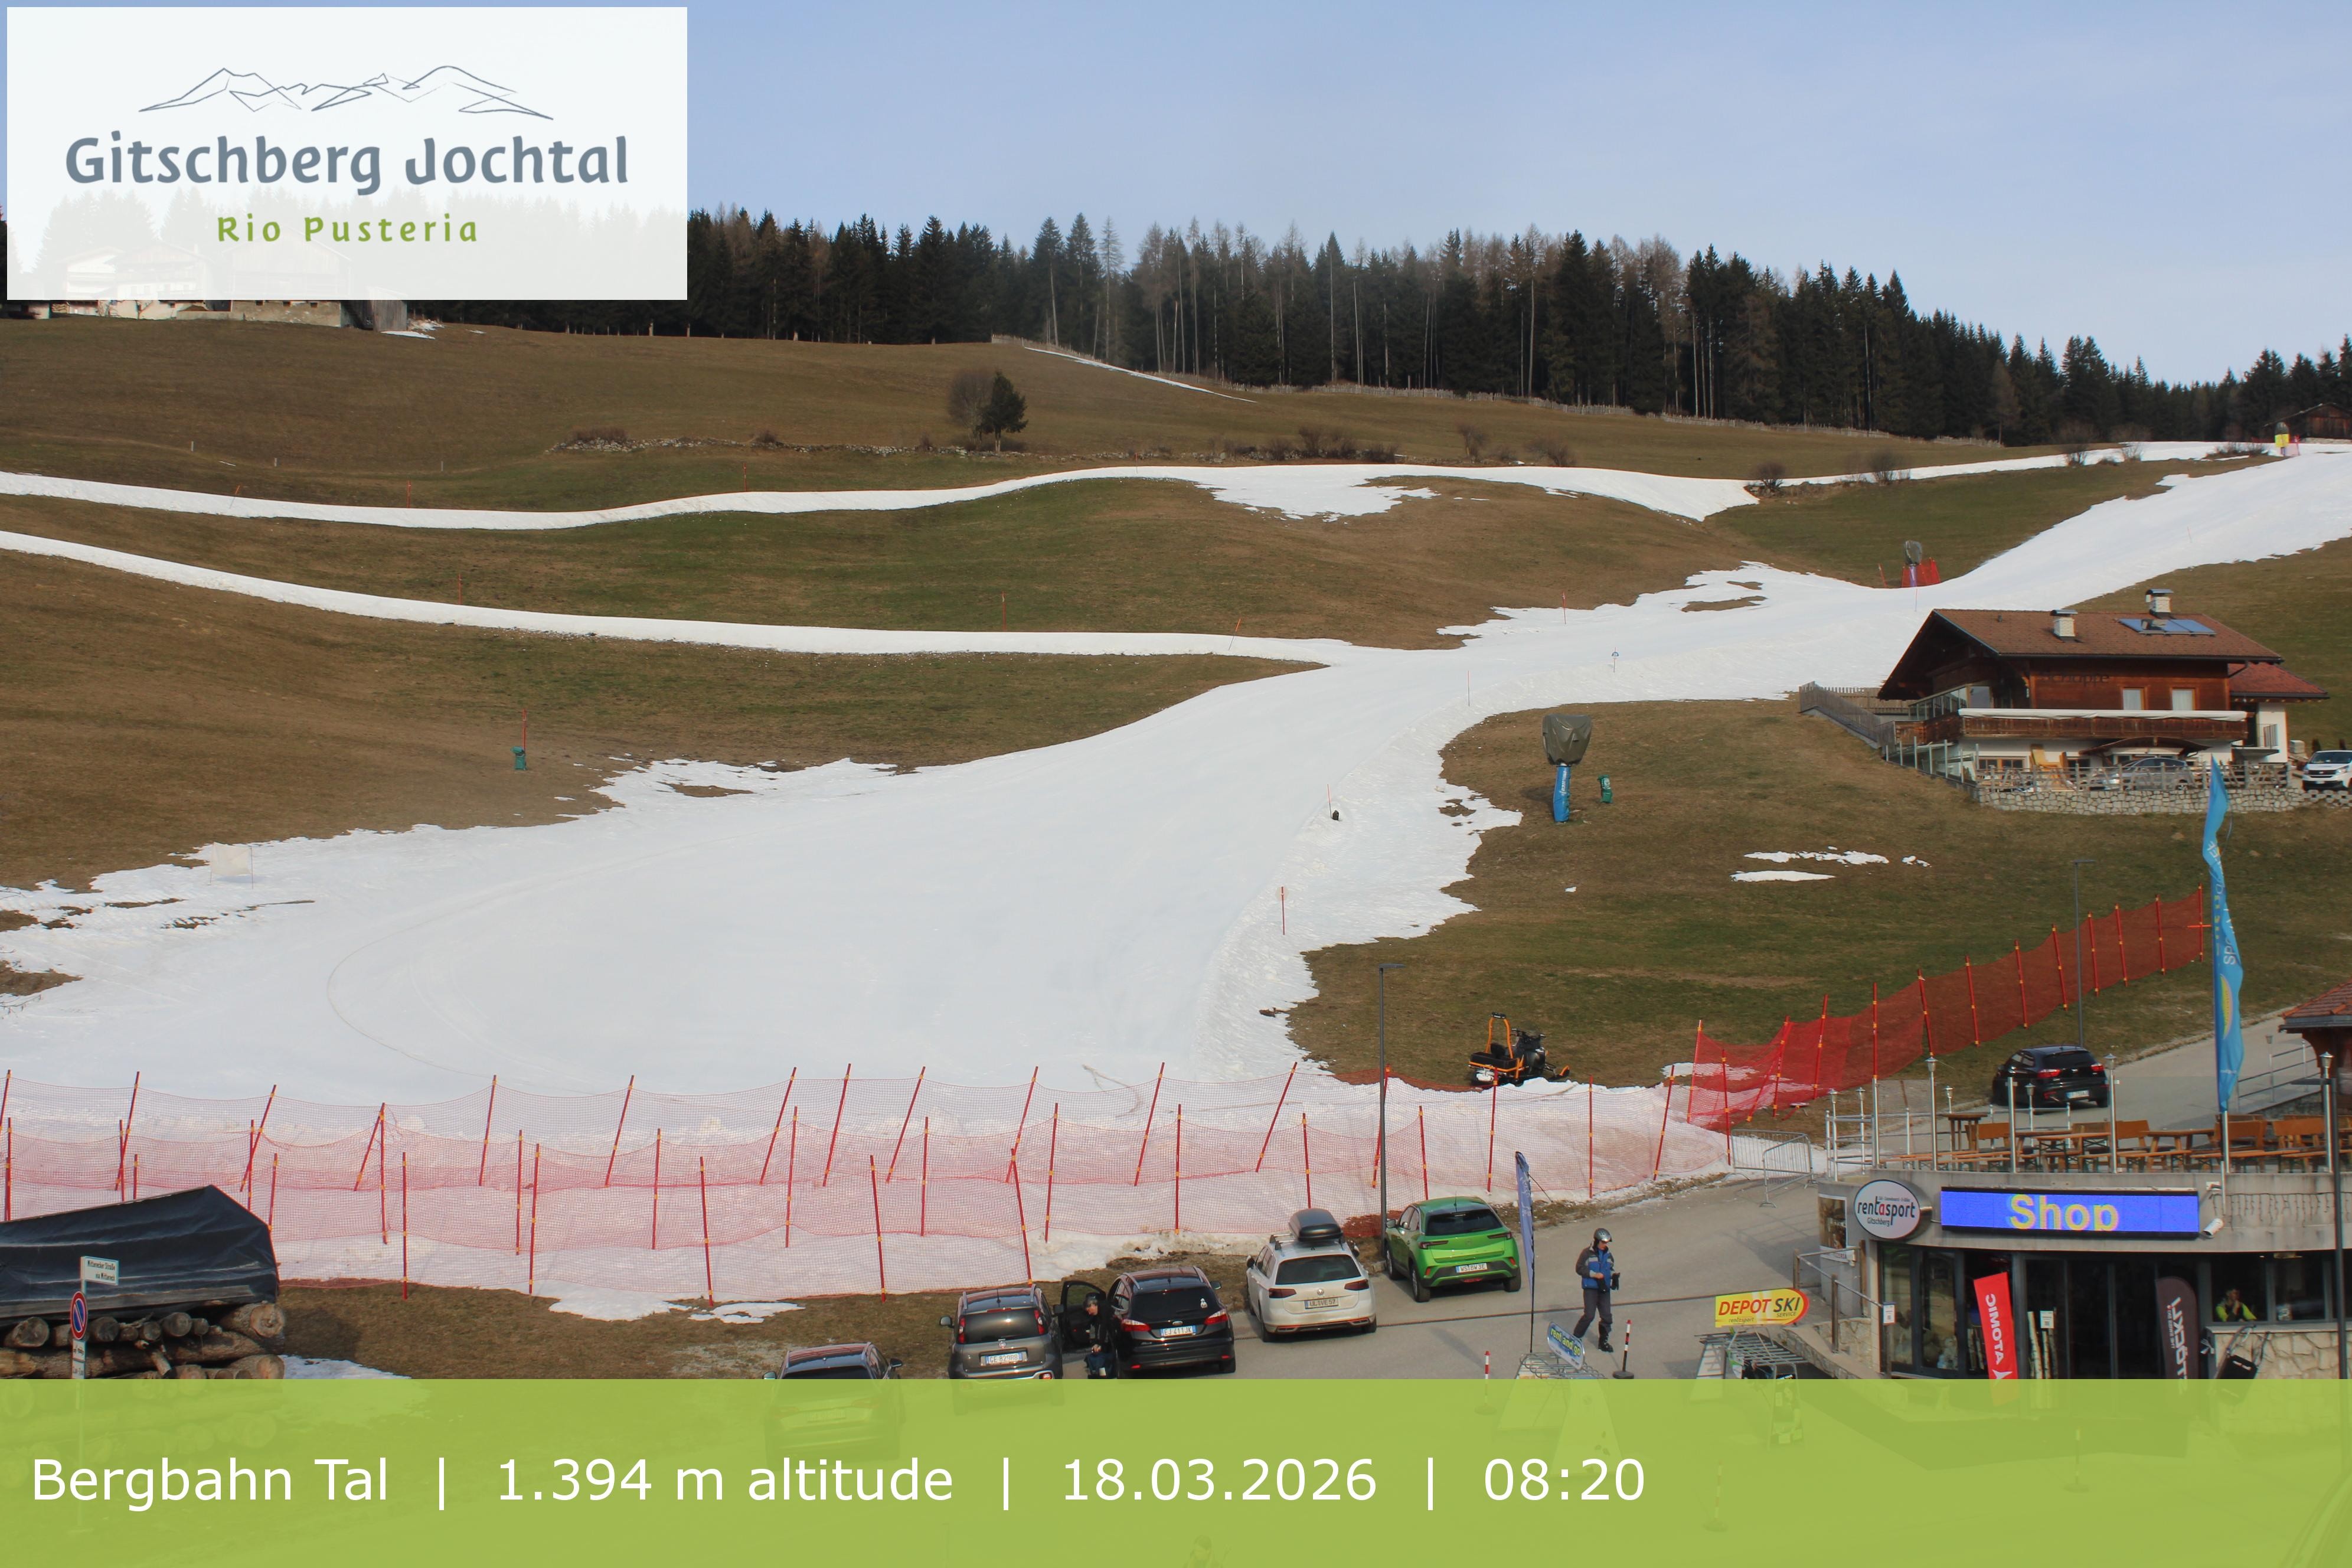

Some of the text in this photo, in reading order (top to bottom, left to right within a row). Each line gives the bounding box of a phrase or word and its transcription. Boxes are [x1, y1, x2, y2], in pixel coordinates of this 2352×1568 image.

[1857, 1195, 1916, 1226] rentasport
[1867, 1217, 1890, 1227] Gitschberg
[2010, 1193, 2120, 1231] Shop
[1719, 1297, 1801, 1315] DEPOT SKI
[1550, 1328, 1562, 1342] rent
[1562, 1337, 1573, 1350] and
[1573, 1345, 1581, 1356] go
